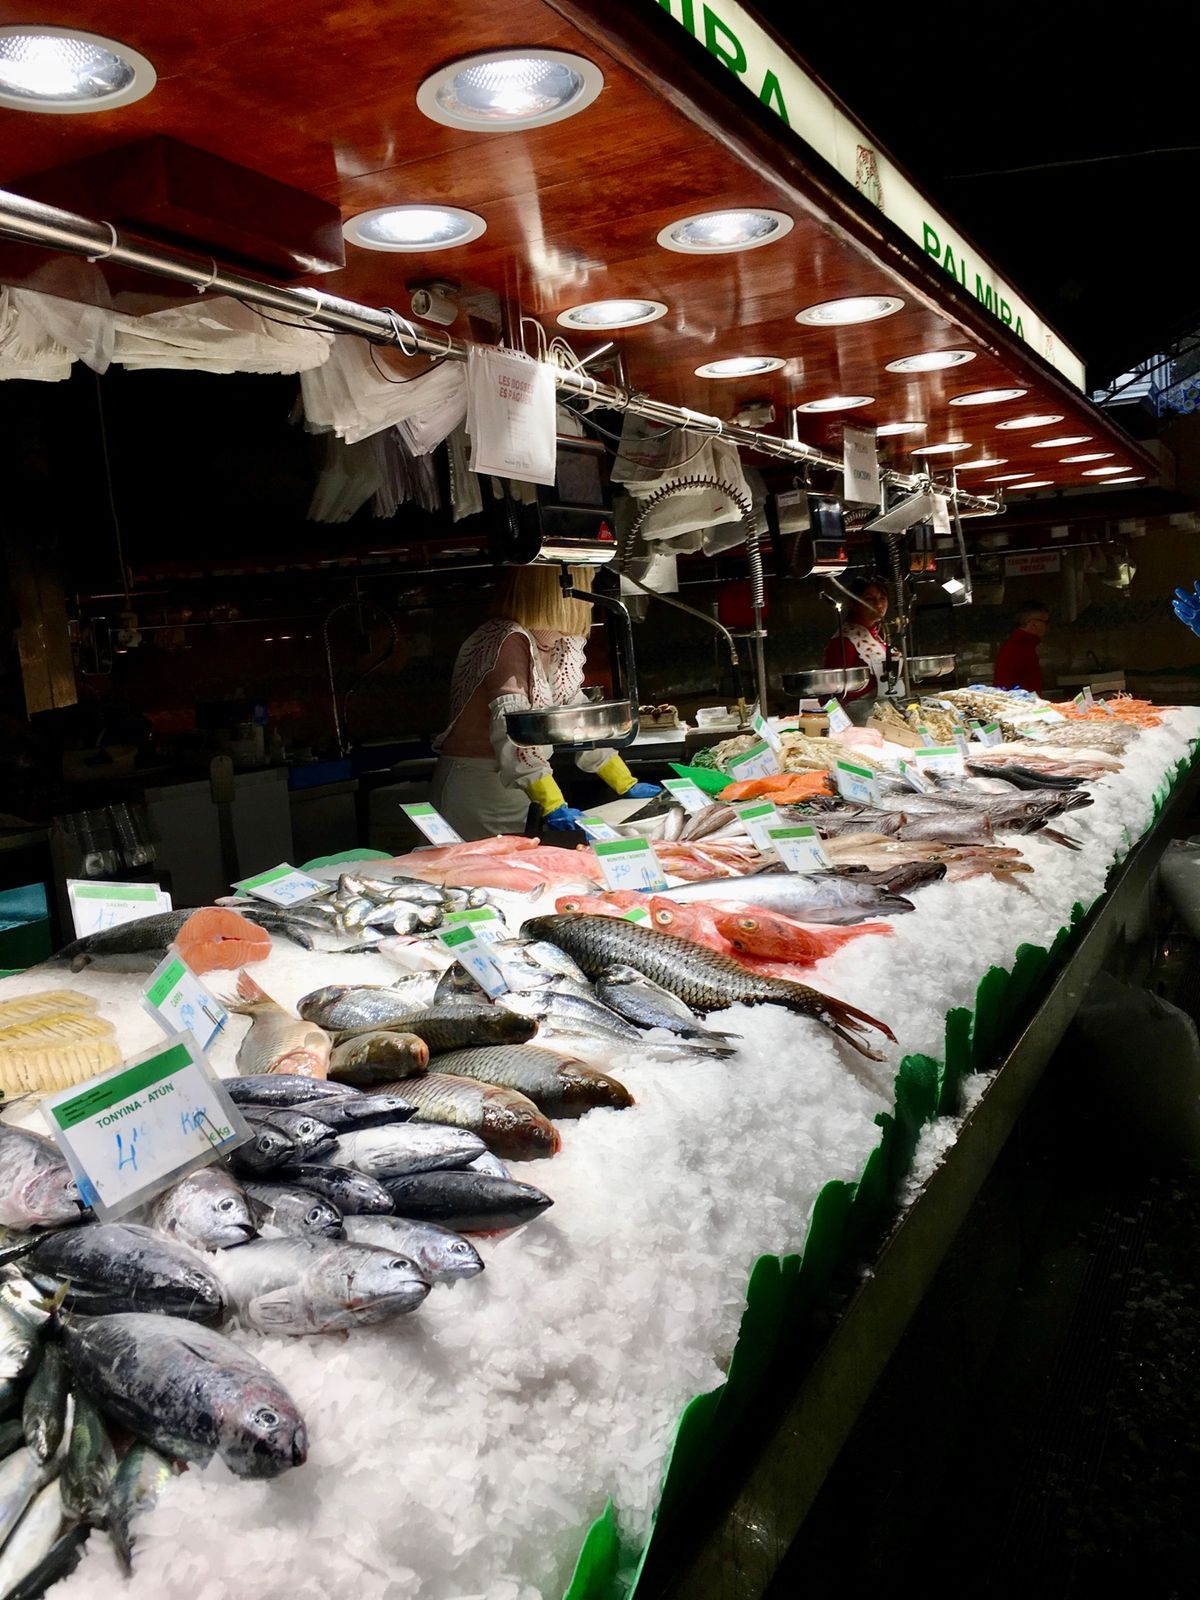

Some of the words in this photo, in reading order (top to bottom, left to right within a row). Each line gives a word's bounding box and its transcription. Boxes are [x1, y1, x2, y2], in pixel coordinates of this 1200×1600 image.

[498, 375, 510, 386] LES
[499, 387, 508, 398] ES
[170, 991, 184, 1007] CARPA
[95, 1102, 143, 1129] TONYINA
[148, 1082, 175, 1103] ATÚN
